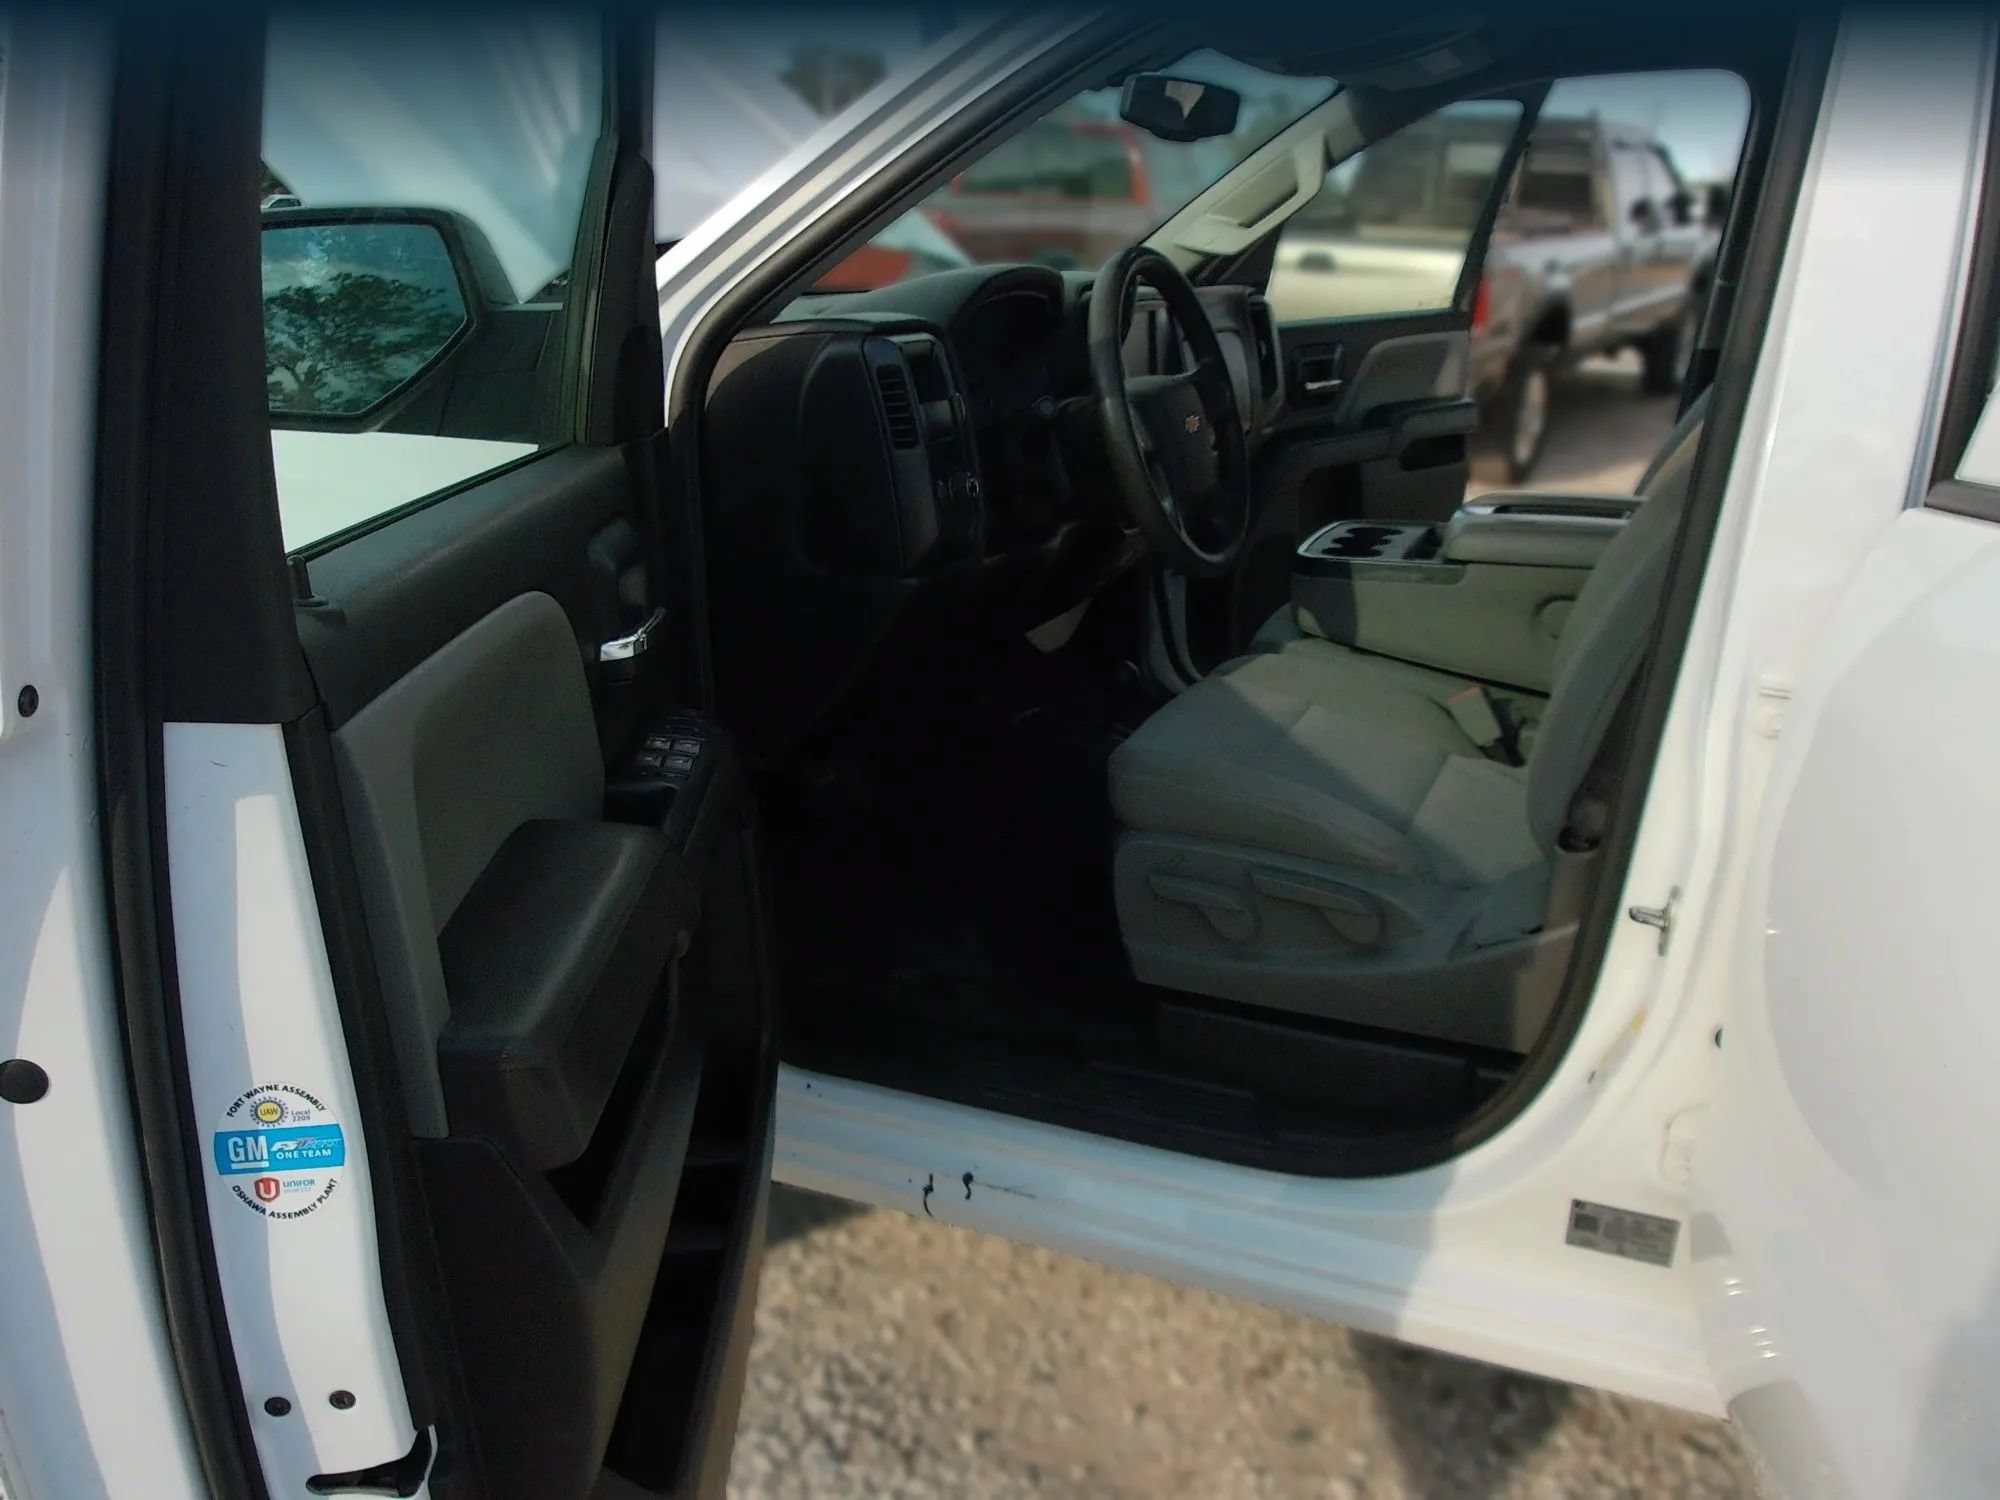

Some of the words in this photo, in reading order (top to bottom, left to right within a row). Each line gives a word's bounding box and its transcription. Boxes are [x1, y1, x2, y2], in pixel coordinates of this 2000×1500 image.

[226, 1097, 245, 1118] FORT
[244, 1084, 280, 1100] WAYNE
[281, 1085, 328, 1112] ASSEMBLY
[260, 1107, 279, 1116] UAW
[227, 1135, 269, 1162] GM
[276, 1150, 300, 1160] ONE
[301, 1148, 332, 1158] TEAM
[232, 1184, 267, 1216] OSHAWA
[268, 1202, 318, 1220] ASSEMBLY
[316, 1178, 338, 1204] PLANT
